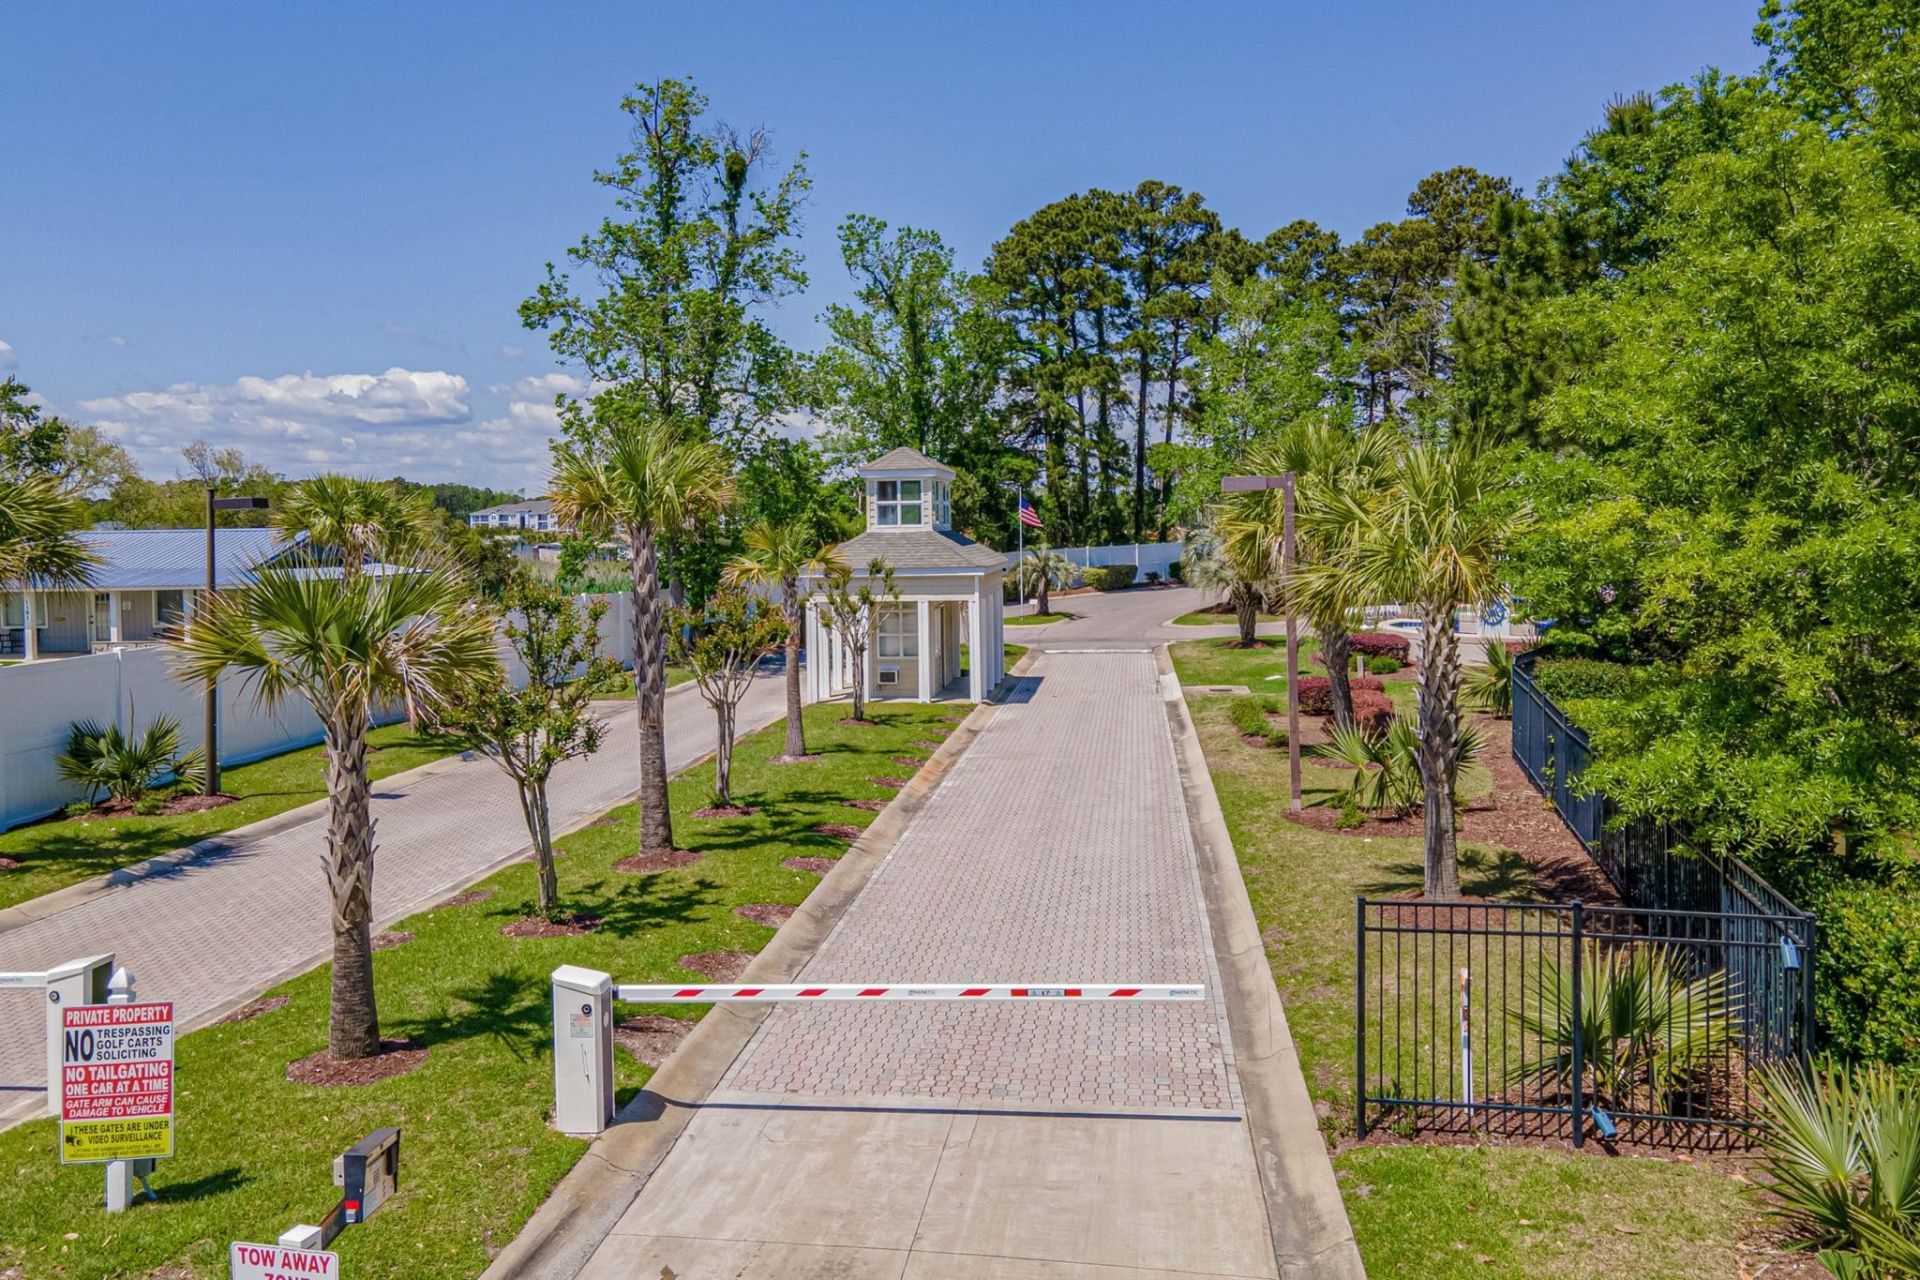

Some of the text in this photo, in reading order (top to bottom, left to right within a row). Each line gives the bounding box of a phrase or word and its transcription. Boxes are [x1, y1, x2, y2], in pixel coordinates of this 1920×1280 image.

[66, 1006, 169, 1026] PRIVATE PROPERTY
[97, 1025, 170, 1038] TRESPASSING
[65, 1028, 94, 1062] NO
[96, 1037, 163, 1050] GOLF CARTS
[96, 1048, 157, 1061] SOLICITING
[66, 1062, 169, 1082] NO TAILGATING
[65, 1078, 169, 1096] ONE CAR AT A TIME
[65, 1094, 168, 1109] GATE ARM CAN CAUSE
[69, 1104, 165, 1118] DAMAGE TO VEHICLE
[74, 1120, 169, 1134] THESE GATES ARE UNDER
[88, 1131, 162, 1145] VIDEO SURVEILLANCE
[238, 1247, 331, 1274] TOW AWAY
